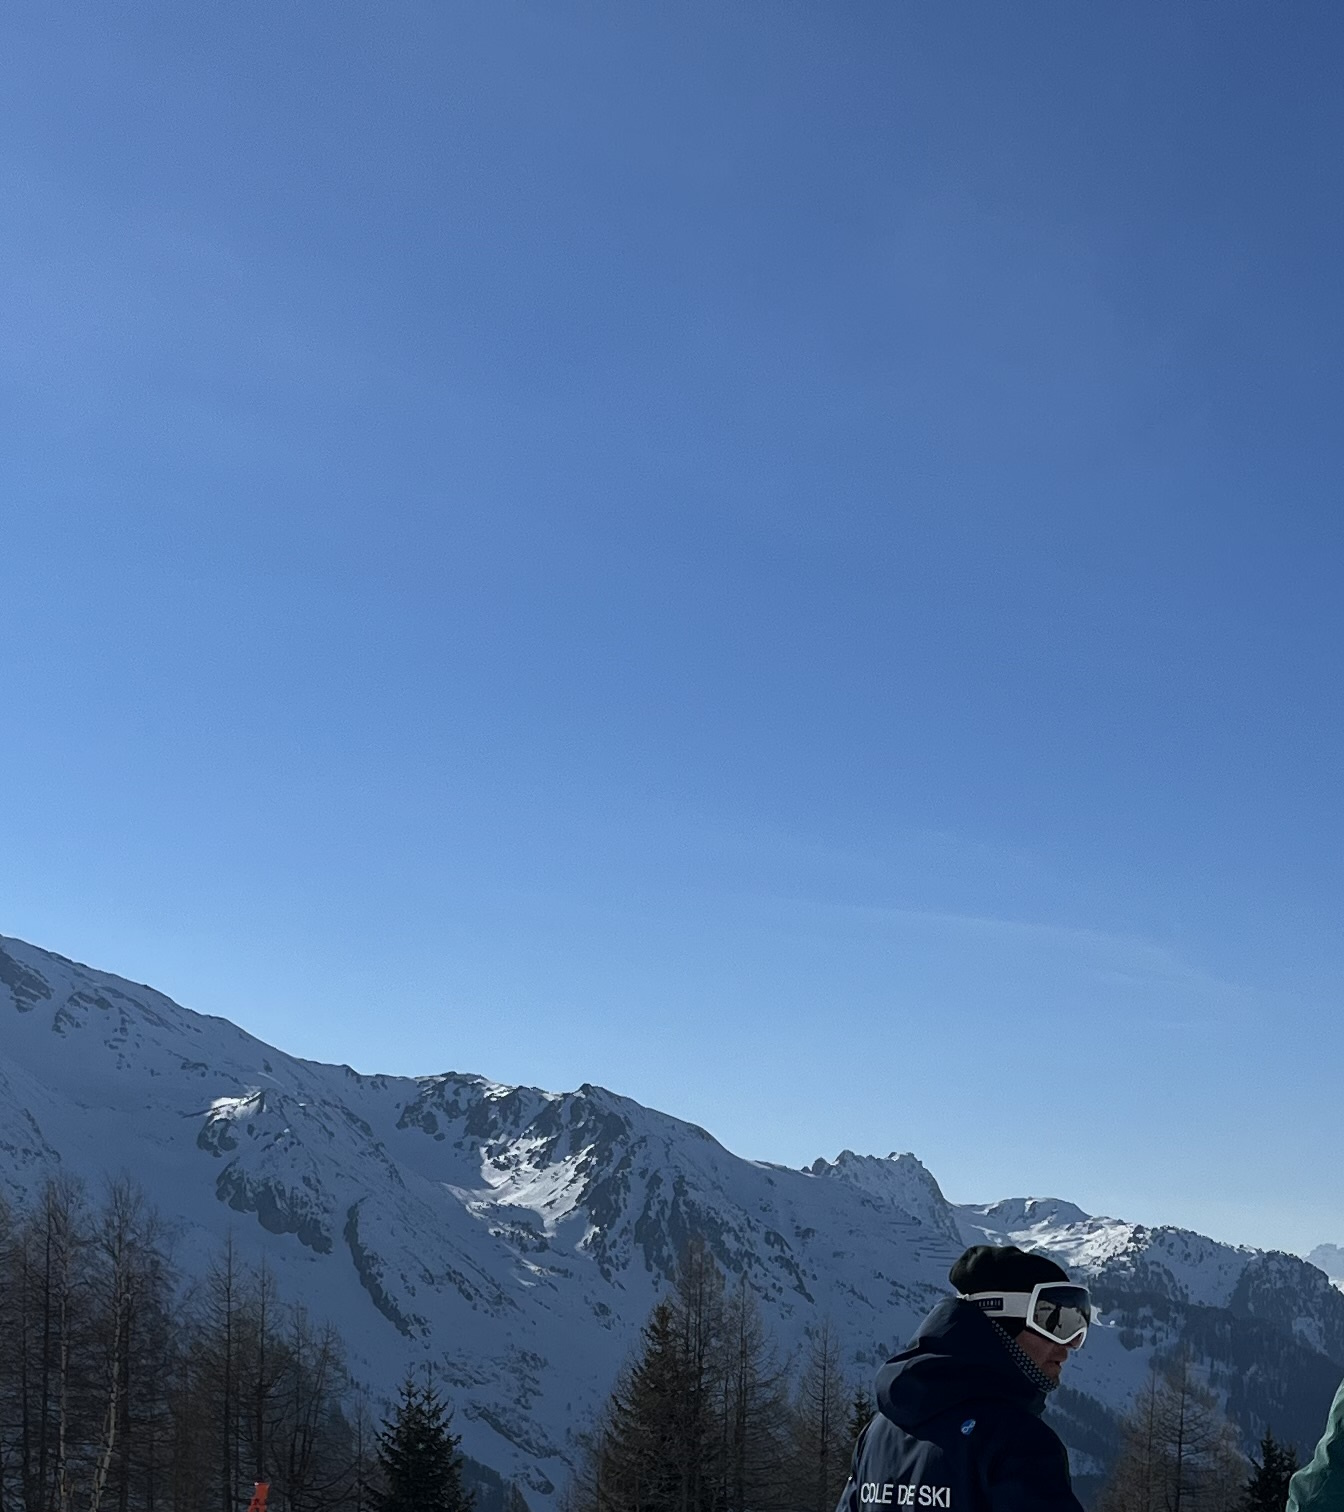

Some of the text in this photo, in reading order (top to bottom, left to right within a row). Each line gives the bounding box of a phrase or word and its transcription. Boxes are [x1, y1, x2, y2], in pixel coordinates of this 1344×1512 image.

[861, 1482, 950, 1508] COLE DE SKI
